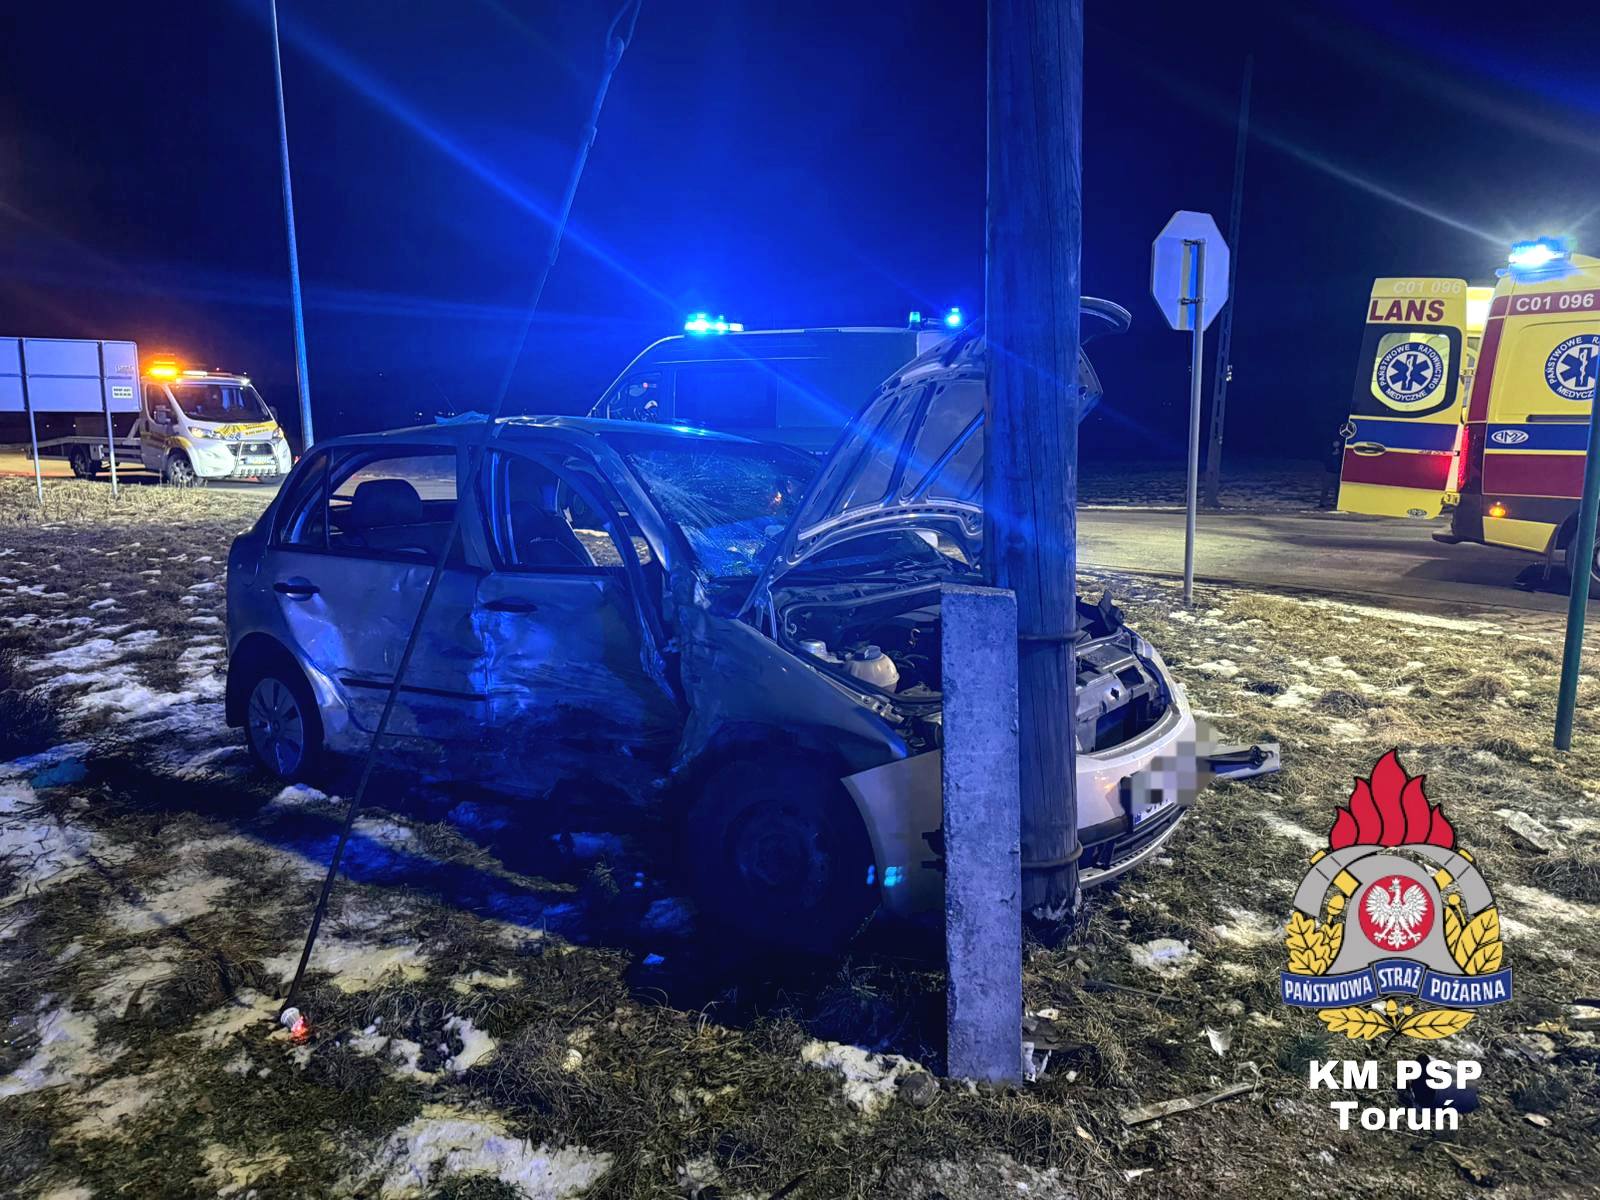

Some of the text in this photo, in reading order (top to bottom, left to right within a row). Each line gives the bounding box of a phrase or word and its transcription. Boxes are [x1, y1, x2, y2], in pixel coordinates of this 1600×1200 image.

[1393, 281, 1461, 294] C01 096
[1369, 299, 1446, 322] LANS
[1516, 293, 1595, 312] C01 096
[1378, 344, 1442, 389] PAŃSTWOWE RATOWNICTWO
[1545, 336, 1583, 384] PAŃSTWOWE
[1386, 388, 1427, 401] MEDYCZNE
[1556, 386, 1594, 399] MEDYCZ
